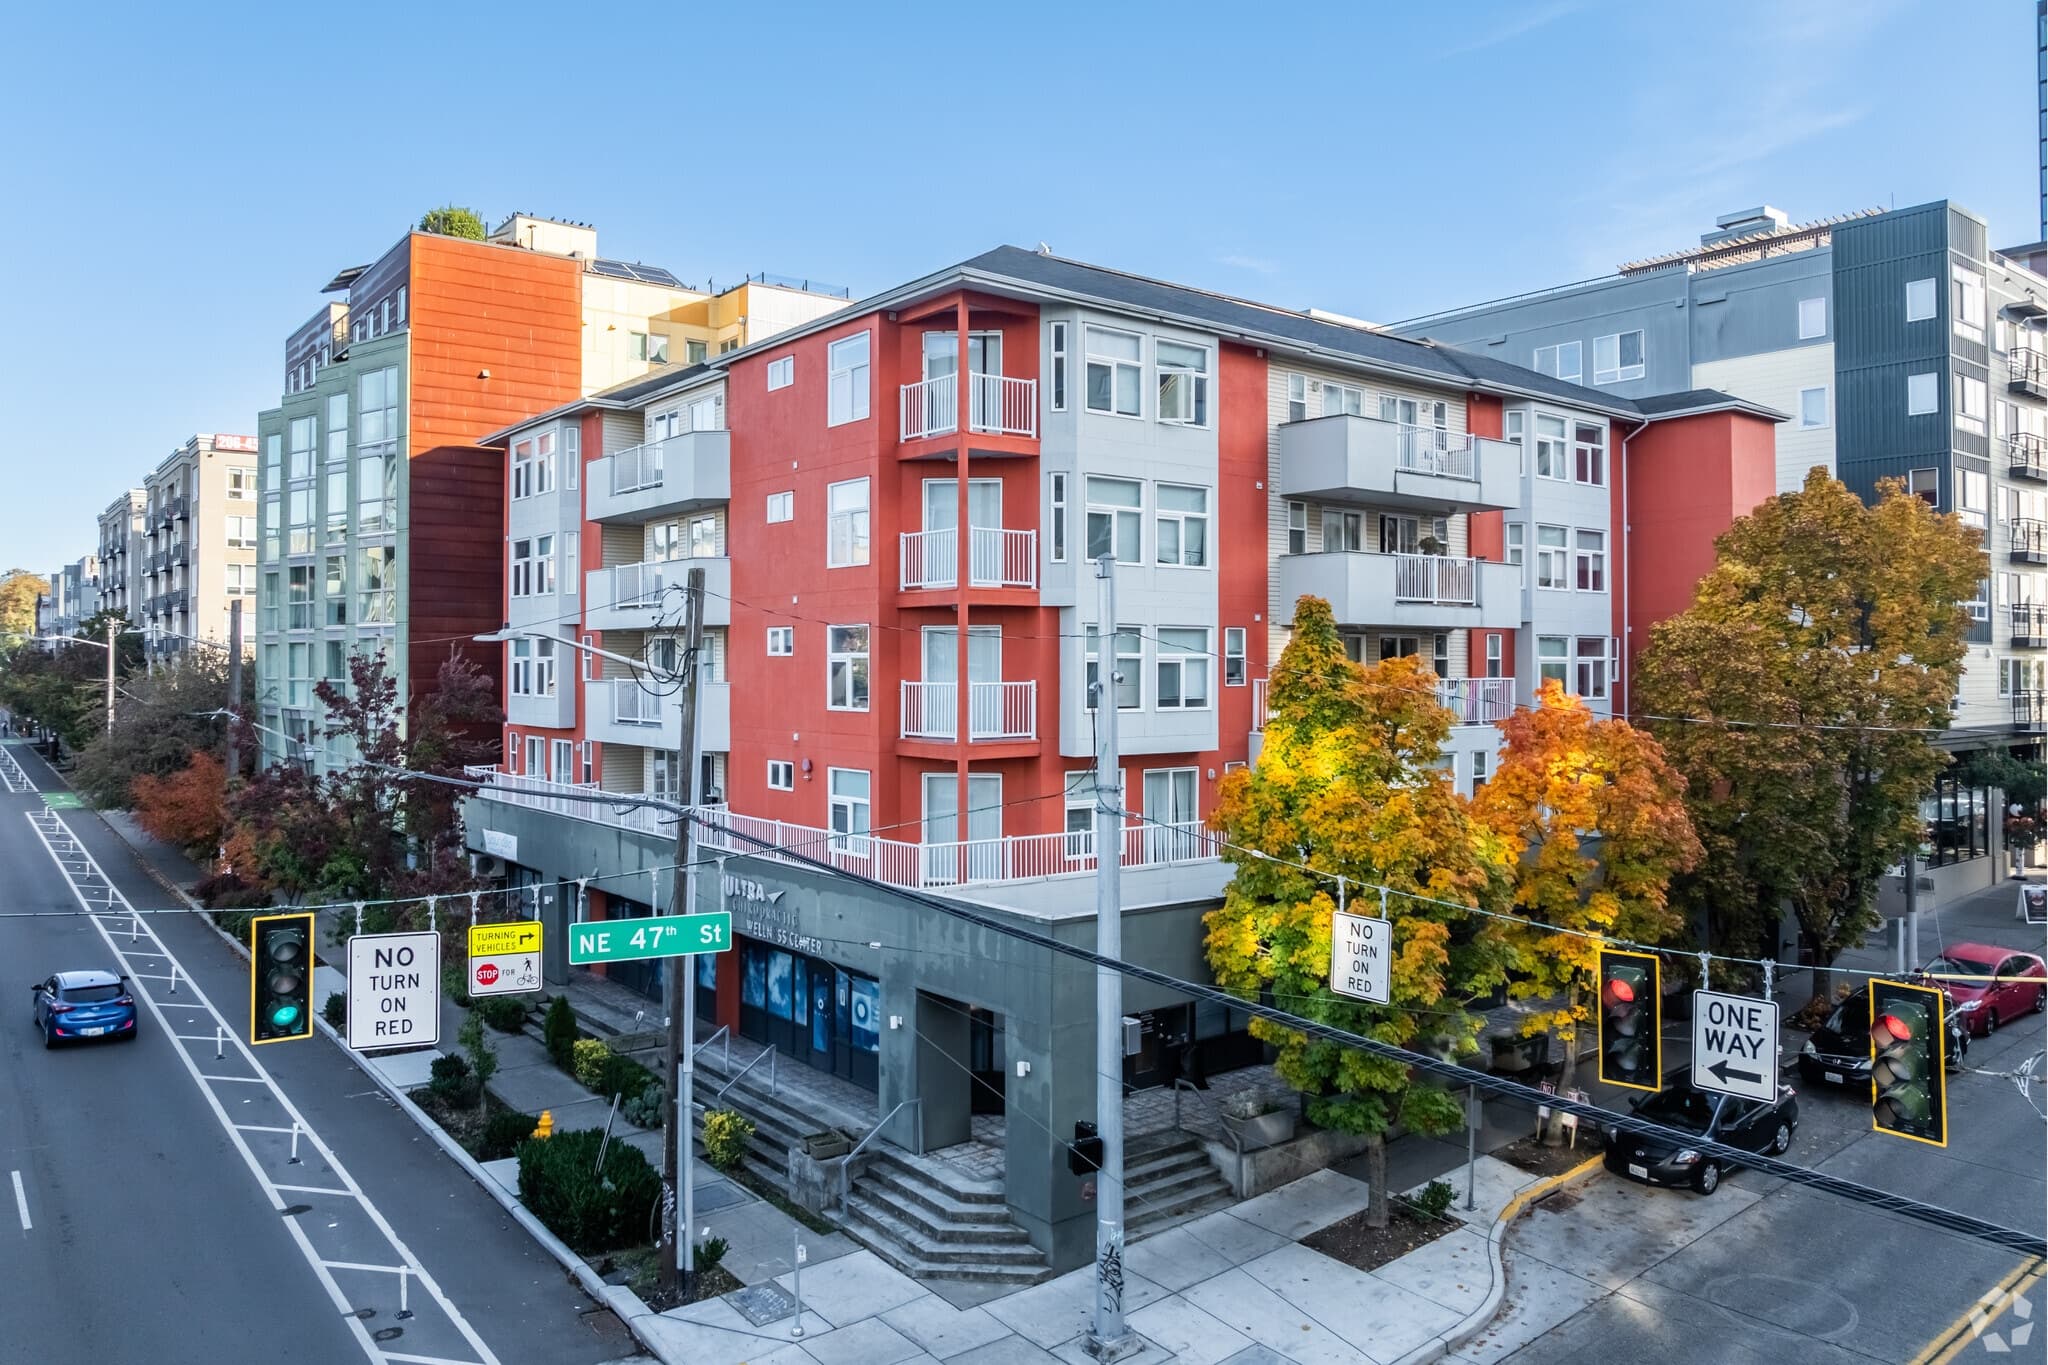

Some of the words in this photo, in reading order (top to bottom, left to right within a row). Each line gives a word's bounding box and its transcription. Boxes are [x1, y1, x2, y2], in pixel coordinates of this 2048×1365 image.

[725, 874, 766, 902] ULTRA
[477, 931, 516, 941] TURNING
[579, 932, 611, 955] NE
[629, 926, 677, 949] 47th
[700, 923, 722, 944] St
[746, 919, 788, 945] WELLNSS
[1350, 921, 1373, 940] NO
[476, 942, 516, 953] VEHICLES
[1346, 940, 1377, 959] TURN
[375, 946, 414, 969] NO
[477, 969, 498, 980] STOP
[1352, 960, 1369, 975] ON
[369, 972, 420, 991] TURN
[1348, 976, 1372, 993] RED
[381, 996, 406, 1013] ON
[1708, 1001, 1762, 1033] ONE
[376, 1018, 413, 1036] RED
[1705, 1027, 1766, 1060] WAY
